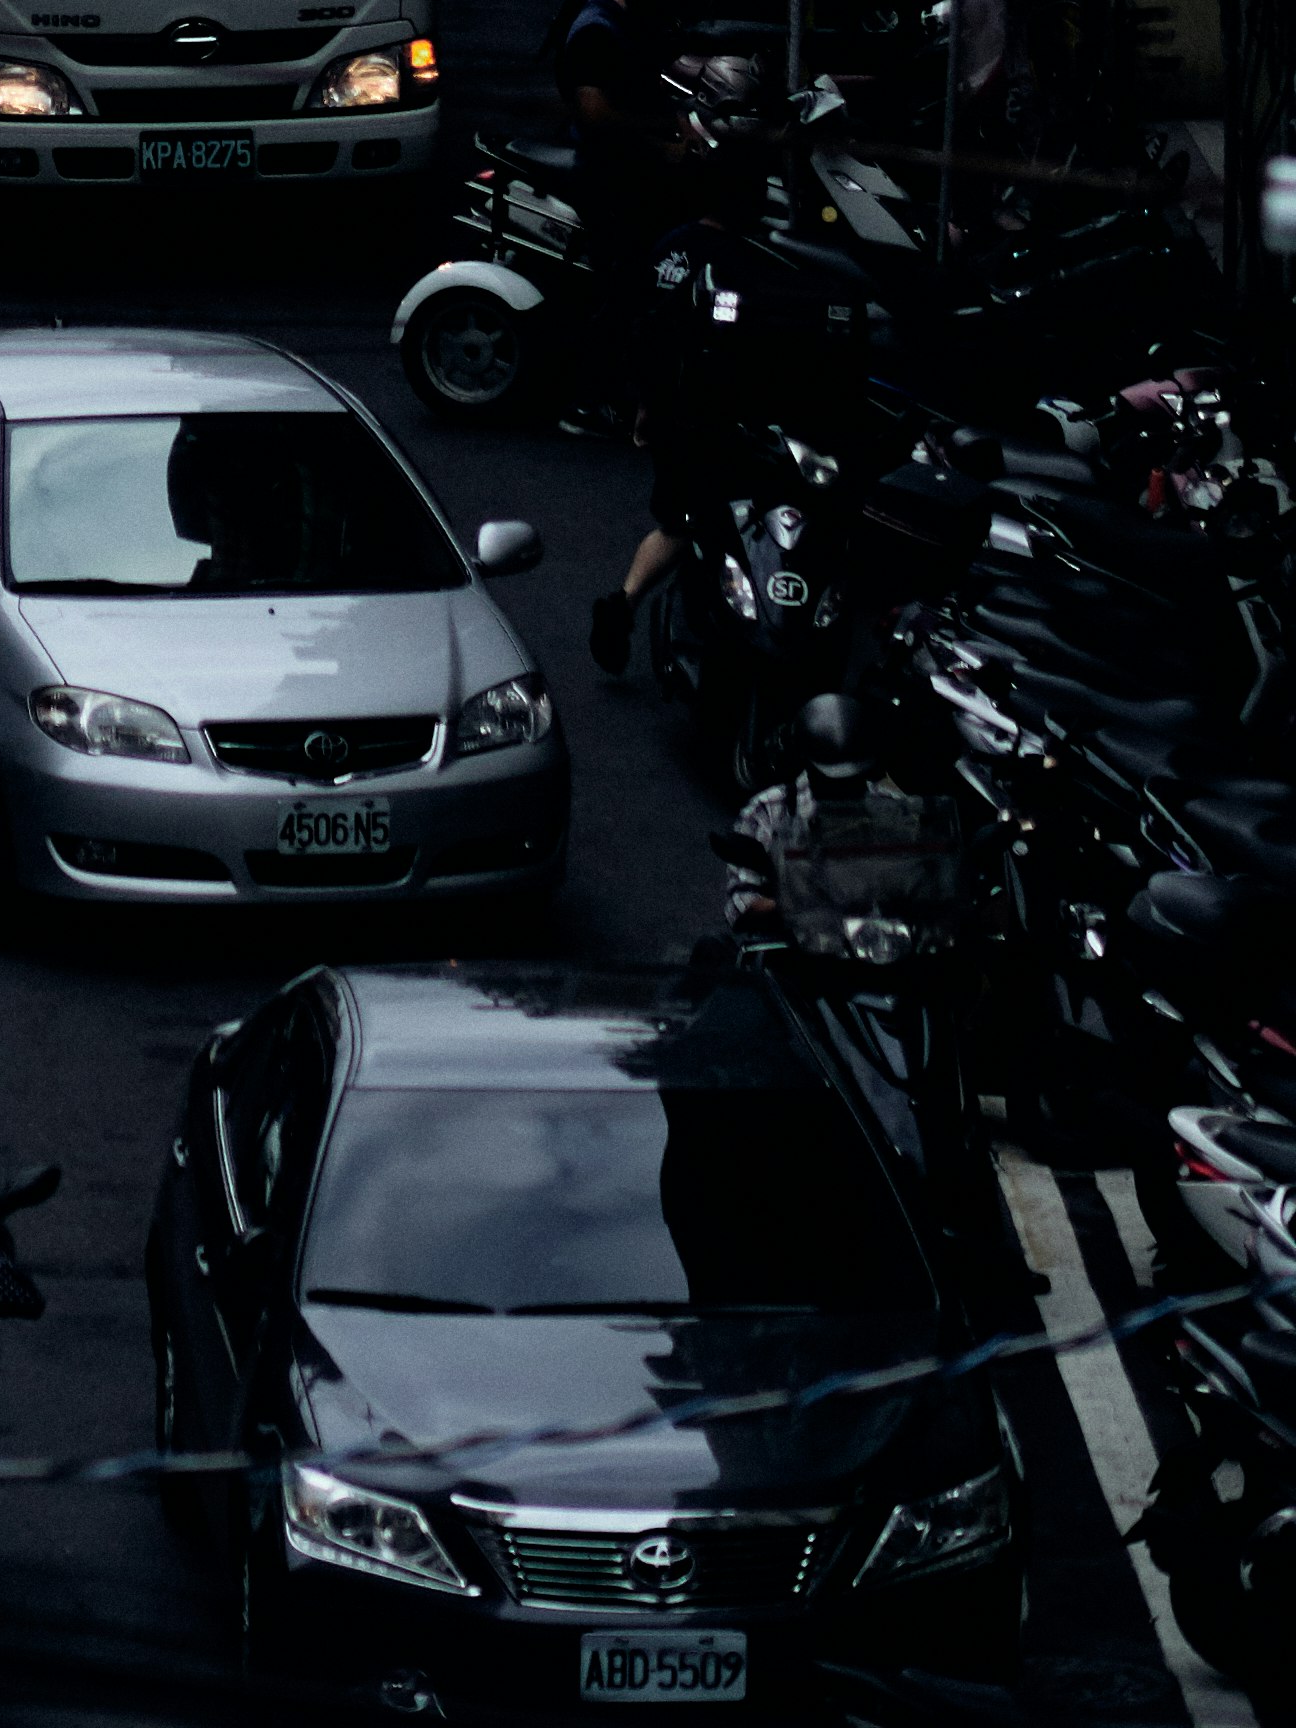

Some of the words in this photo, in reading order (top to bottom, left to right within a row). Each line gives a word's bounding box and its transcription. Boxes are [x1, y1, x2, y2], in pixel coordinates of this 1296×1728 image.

[30, 14, 100, 28] HINO
[139, 138, 254, 171] KPA-8275
[584, 1649, 745, 1691] ABD-5509
